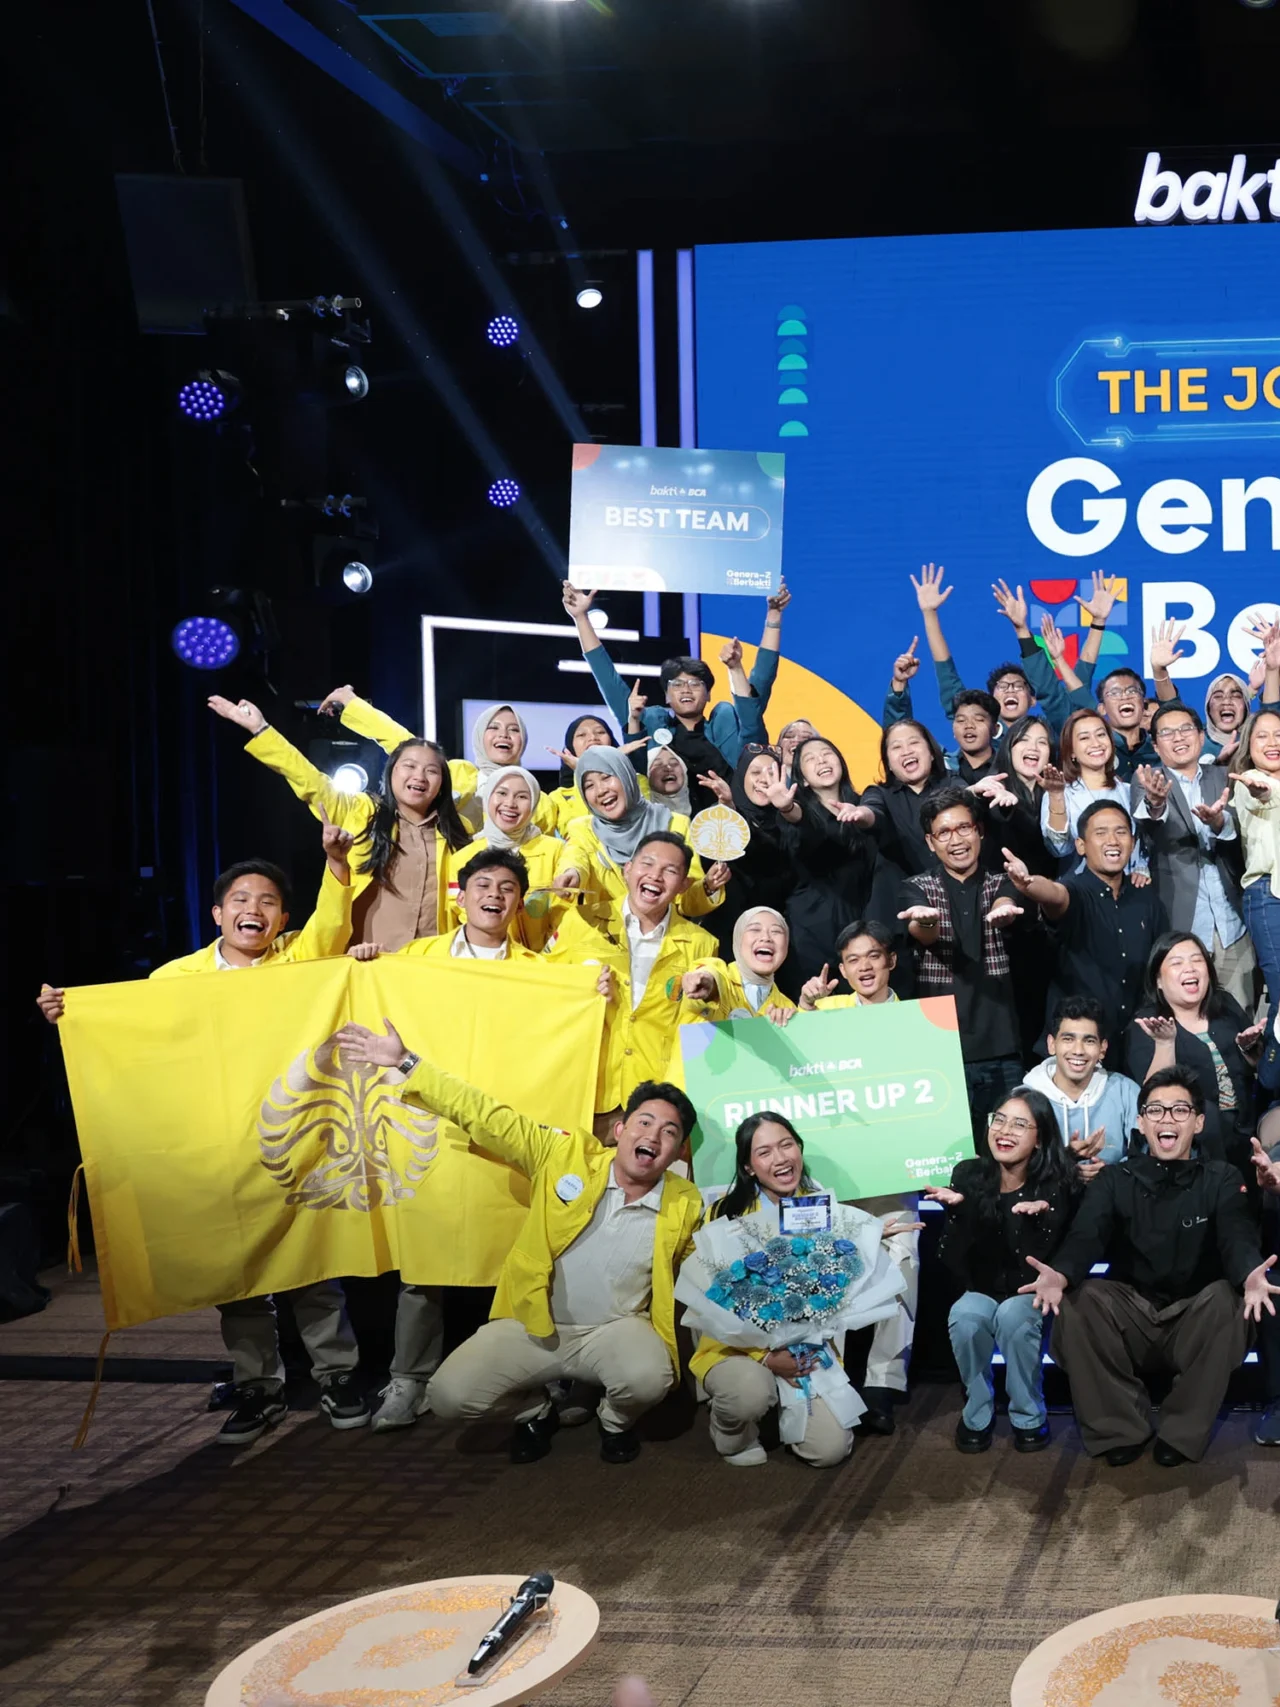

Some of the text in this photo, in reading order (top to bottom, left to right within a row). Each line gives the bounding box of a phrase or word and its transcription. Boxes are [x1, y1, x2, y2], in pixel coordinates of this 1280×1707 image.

[1098, 368, 1209, 414] THE
[650, 484, 707, 497] bakti BCA
[605, 506, 749, 531] BEST TEAM
[789, 1060, 825, 1078] bakti
[865, 1082, 906, 1110] UP
[913, 1079, 934, 1104] 2
